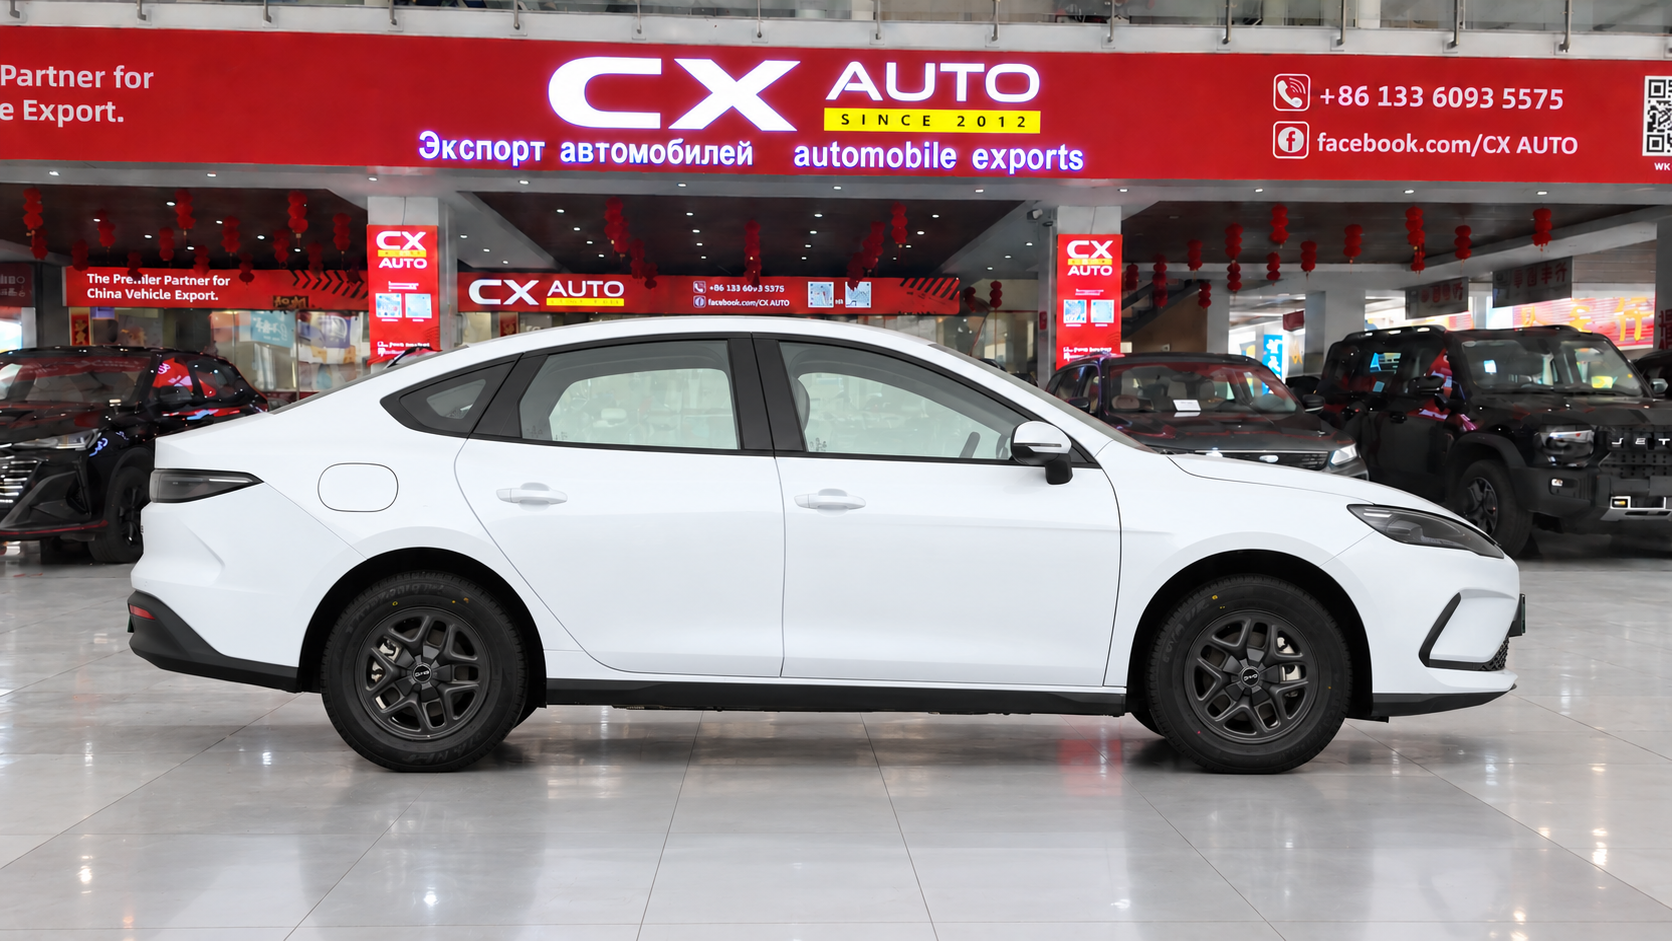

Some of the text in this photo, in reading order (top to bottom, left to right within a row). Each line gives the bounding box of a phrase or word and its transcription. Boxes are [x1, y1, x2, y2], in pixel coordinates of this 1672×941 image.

[0, 64, 154, 89] Partner for
[547, 56, 1041, 132] CX AUTO
[1319, 85, 1564, 110] +86 133 6093 5575
[23, 99, 124, 128] Export.
[841, 113, 1026, 128] SINCE 2012
[418, 130, 754, 167] Экспорт автомобилей
[1316, 131, 1578, 158] facebook.com/CX AUTO
[793, 141, 1085, 175] automobile exports
[375, 230, 427, 251] CX
[1066, 239, 1114, 259] CX
[378, 257, 428, 269] AUTO
[1067, 264, 1113, 277] AUTO
[86, 273, 111, 285] The
[163, 275, 211, 287] Partner
[212, 275, 231, 287] for
[468, 278, 625, 307] CX AUTO
[86, 287, 219, 304] China Vehicle Export.
